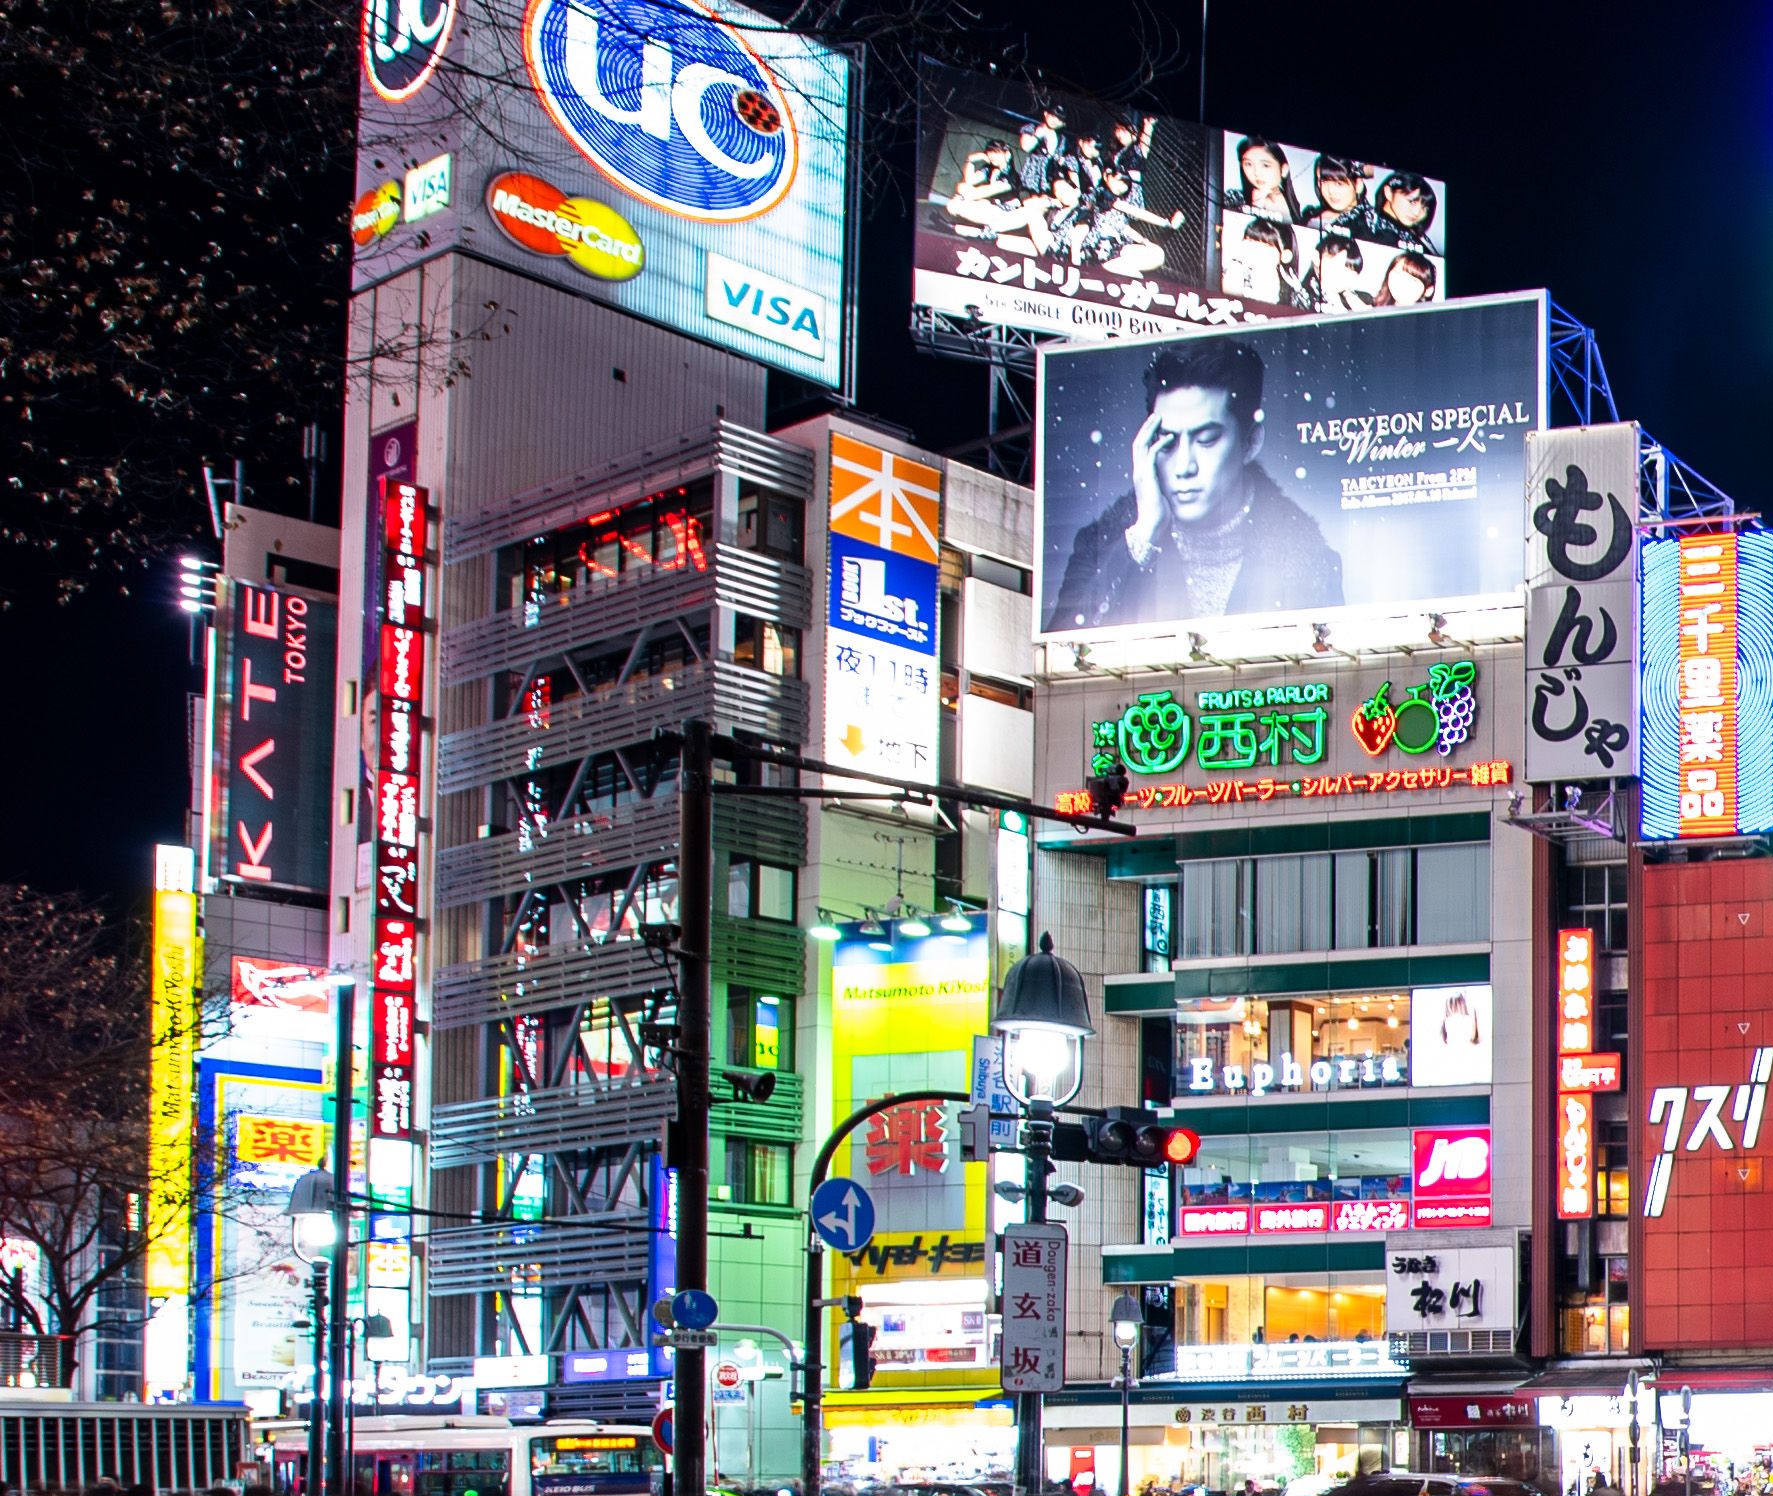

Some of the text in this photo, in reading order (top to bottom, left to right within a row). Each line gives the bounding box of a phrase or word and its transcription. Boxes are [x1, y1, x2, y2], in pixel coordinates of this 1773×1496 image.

[410, 169, 448, 210] VISA
[493, 188, 643, 264] MasterCard
[955, 245, 1244, 326] カントリー・ガールズ
[722, 278, 822, 341] VISA
[1013, 299, 1063, 321] SINGLE
[1071, 306, 1123, 332] GOOD
[1296, 401, 1530, 444] TAECYEON SPECIAL
[840, 608, 928, 644] ブックファースト
[1532, 464, 1633, 768] もんじゃ
[284, 596, 308, 684] TOKYO
[1681, 543, 1726, 818] 三千里薬品
[236, 588, 280, 881] KATE
[1197, 710, 1329, 770] 西村
[843, 984, 934, 1001] Matsumoto
[977, 1057, 990, 1099] Shibuya
[1188, 1050, 1399, 1096] Euphoria
[253, 1120, 315, 1162] 薬
[1418, 1136, 1490, 1187] JTB
[1010, 1240, 1043, 1375] 道玄坂
[1410, 1278, 1481, 1318] 松川
[1201, 1403, 1310, 1422] 渋谷 西村
[544, 1483, 596, 1496] KEIO BUS
